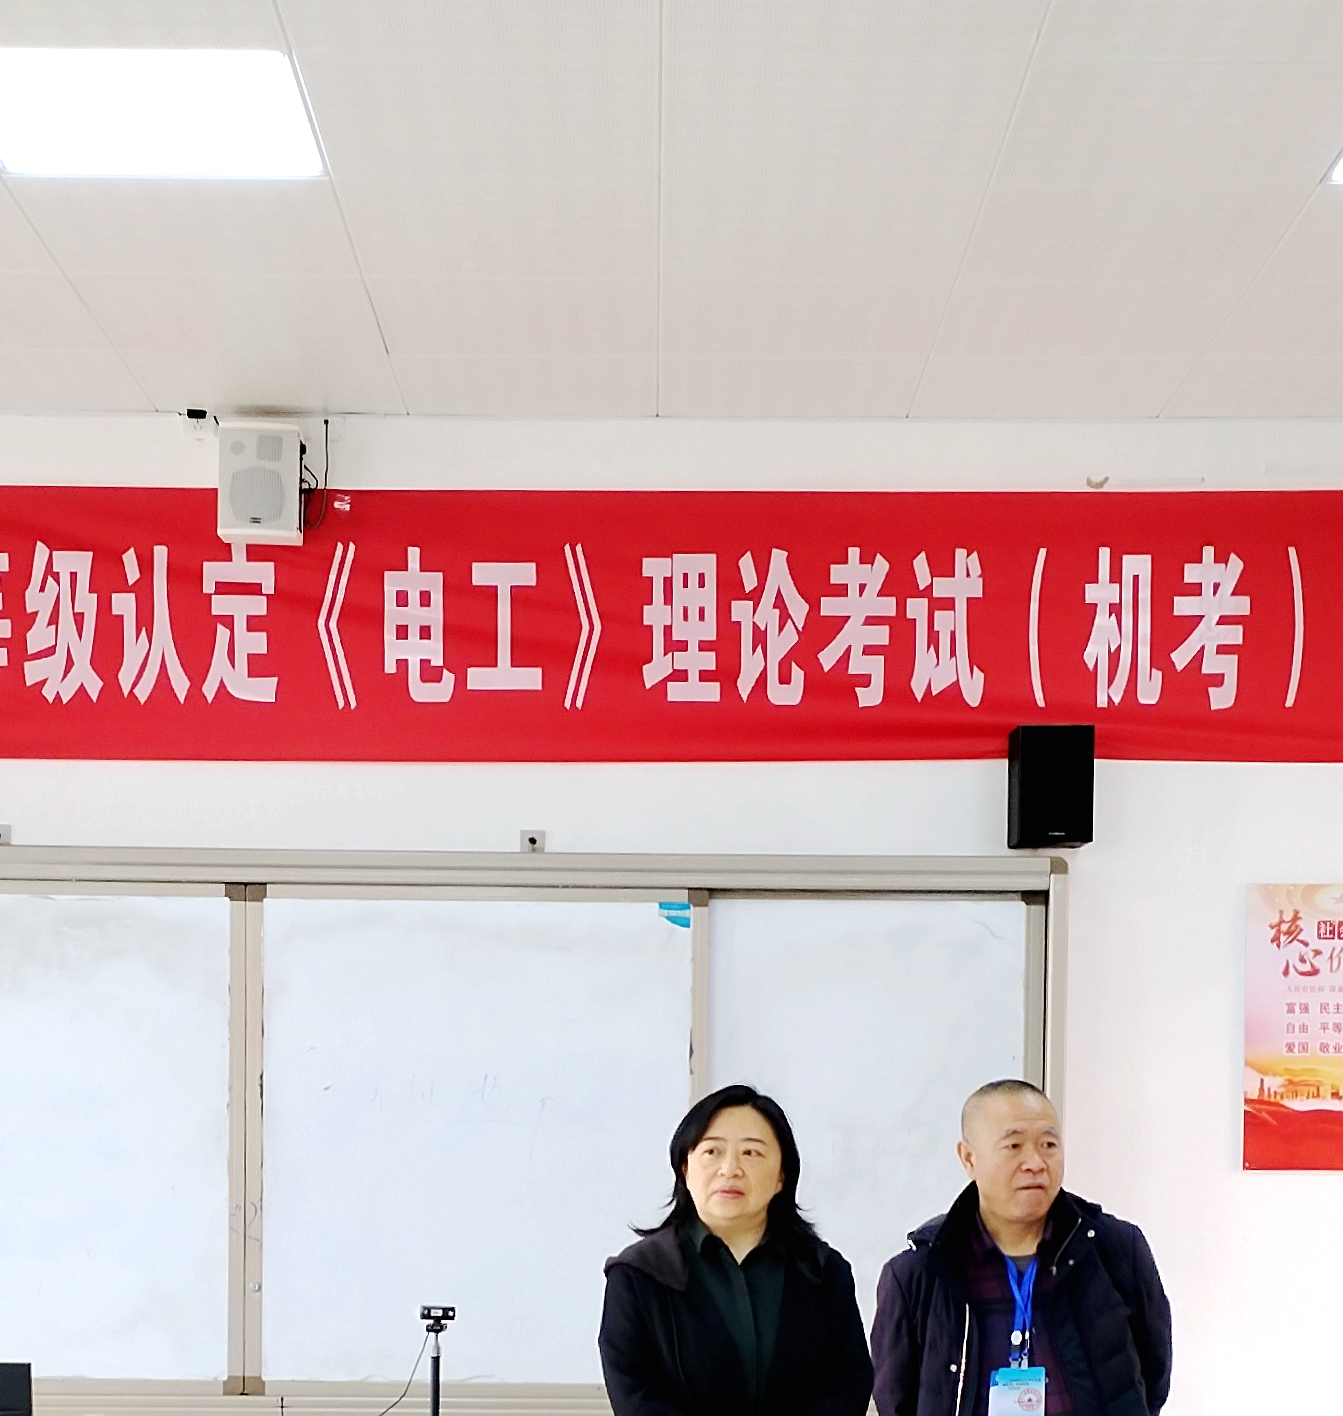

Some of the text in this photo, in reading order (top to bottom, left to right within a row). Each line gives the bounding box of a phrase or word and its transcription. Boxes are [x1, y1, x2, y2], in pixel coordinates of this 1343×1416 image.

[1285, 1002, 1310, 1015] 富强
[1319, 1002, 1343, 1015] 民主
[1285, 1022, 1310, 1035] 自由
[1319, 1022, 1343, 1035] 平等
[1285, 1042, 1310, 1055] 爱国
[1319, 1042, 1343, 1055] 敬业
